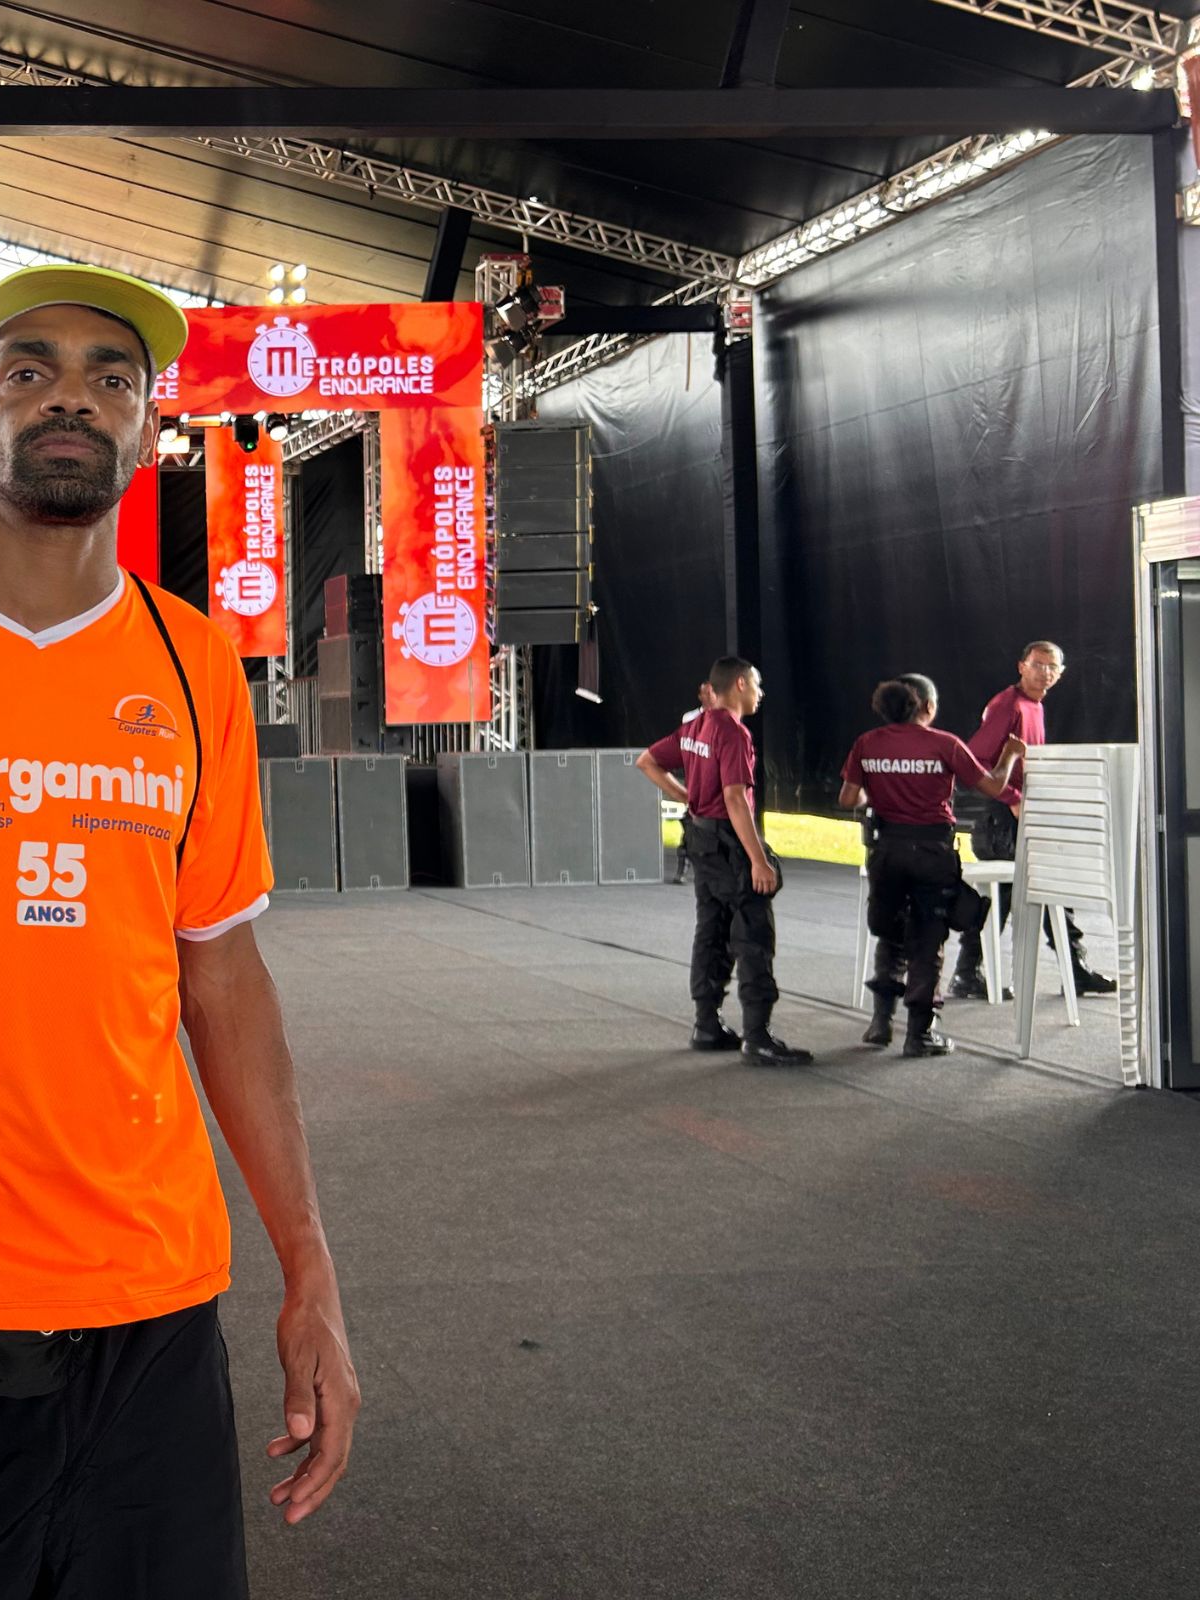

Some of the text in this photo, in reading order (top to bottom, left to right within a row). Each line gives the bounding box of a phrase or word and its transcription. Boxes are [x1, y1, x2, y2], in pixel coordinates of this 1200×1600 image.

[266, 346, 435, 378] METRÓPOLES
[318, 374, 434, 397] ENDURANCE
[260, 464, 276, 559] ENDURANCE
[456, 466, 475, 590] ENDURANCE
[118, 721, 157, 737] Coyotes
[861, 758, 943, 774] BRIGADISTA
[16, 840, 87, 898] 55
[23, 905, 77, 923] ANOS
